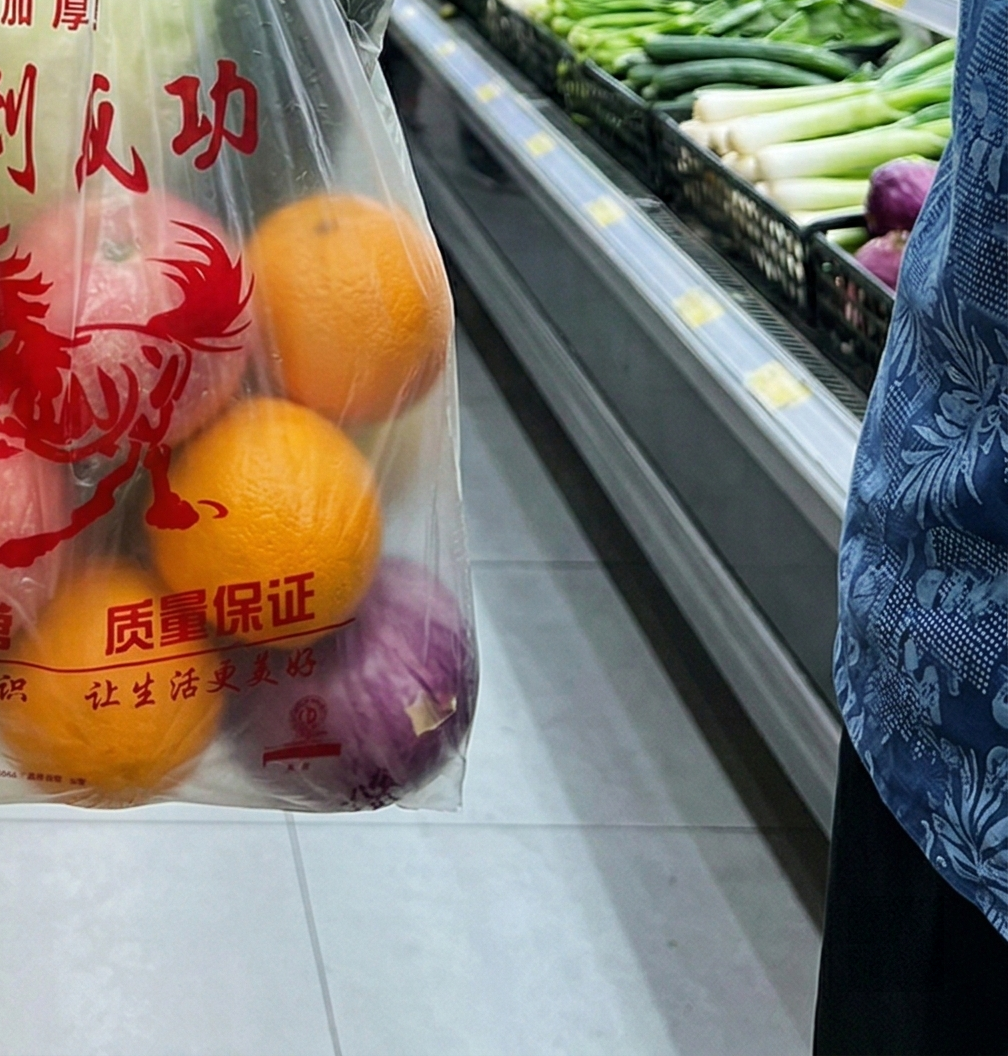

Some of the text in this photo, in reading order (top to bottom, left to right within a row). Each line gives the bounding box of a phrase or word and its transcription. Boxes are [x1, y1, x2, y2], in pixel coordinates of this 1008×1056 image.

[105, 571, 315, 656] 质量保证
[85, 647, 317, 710] 让生活更美好
